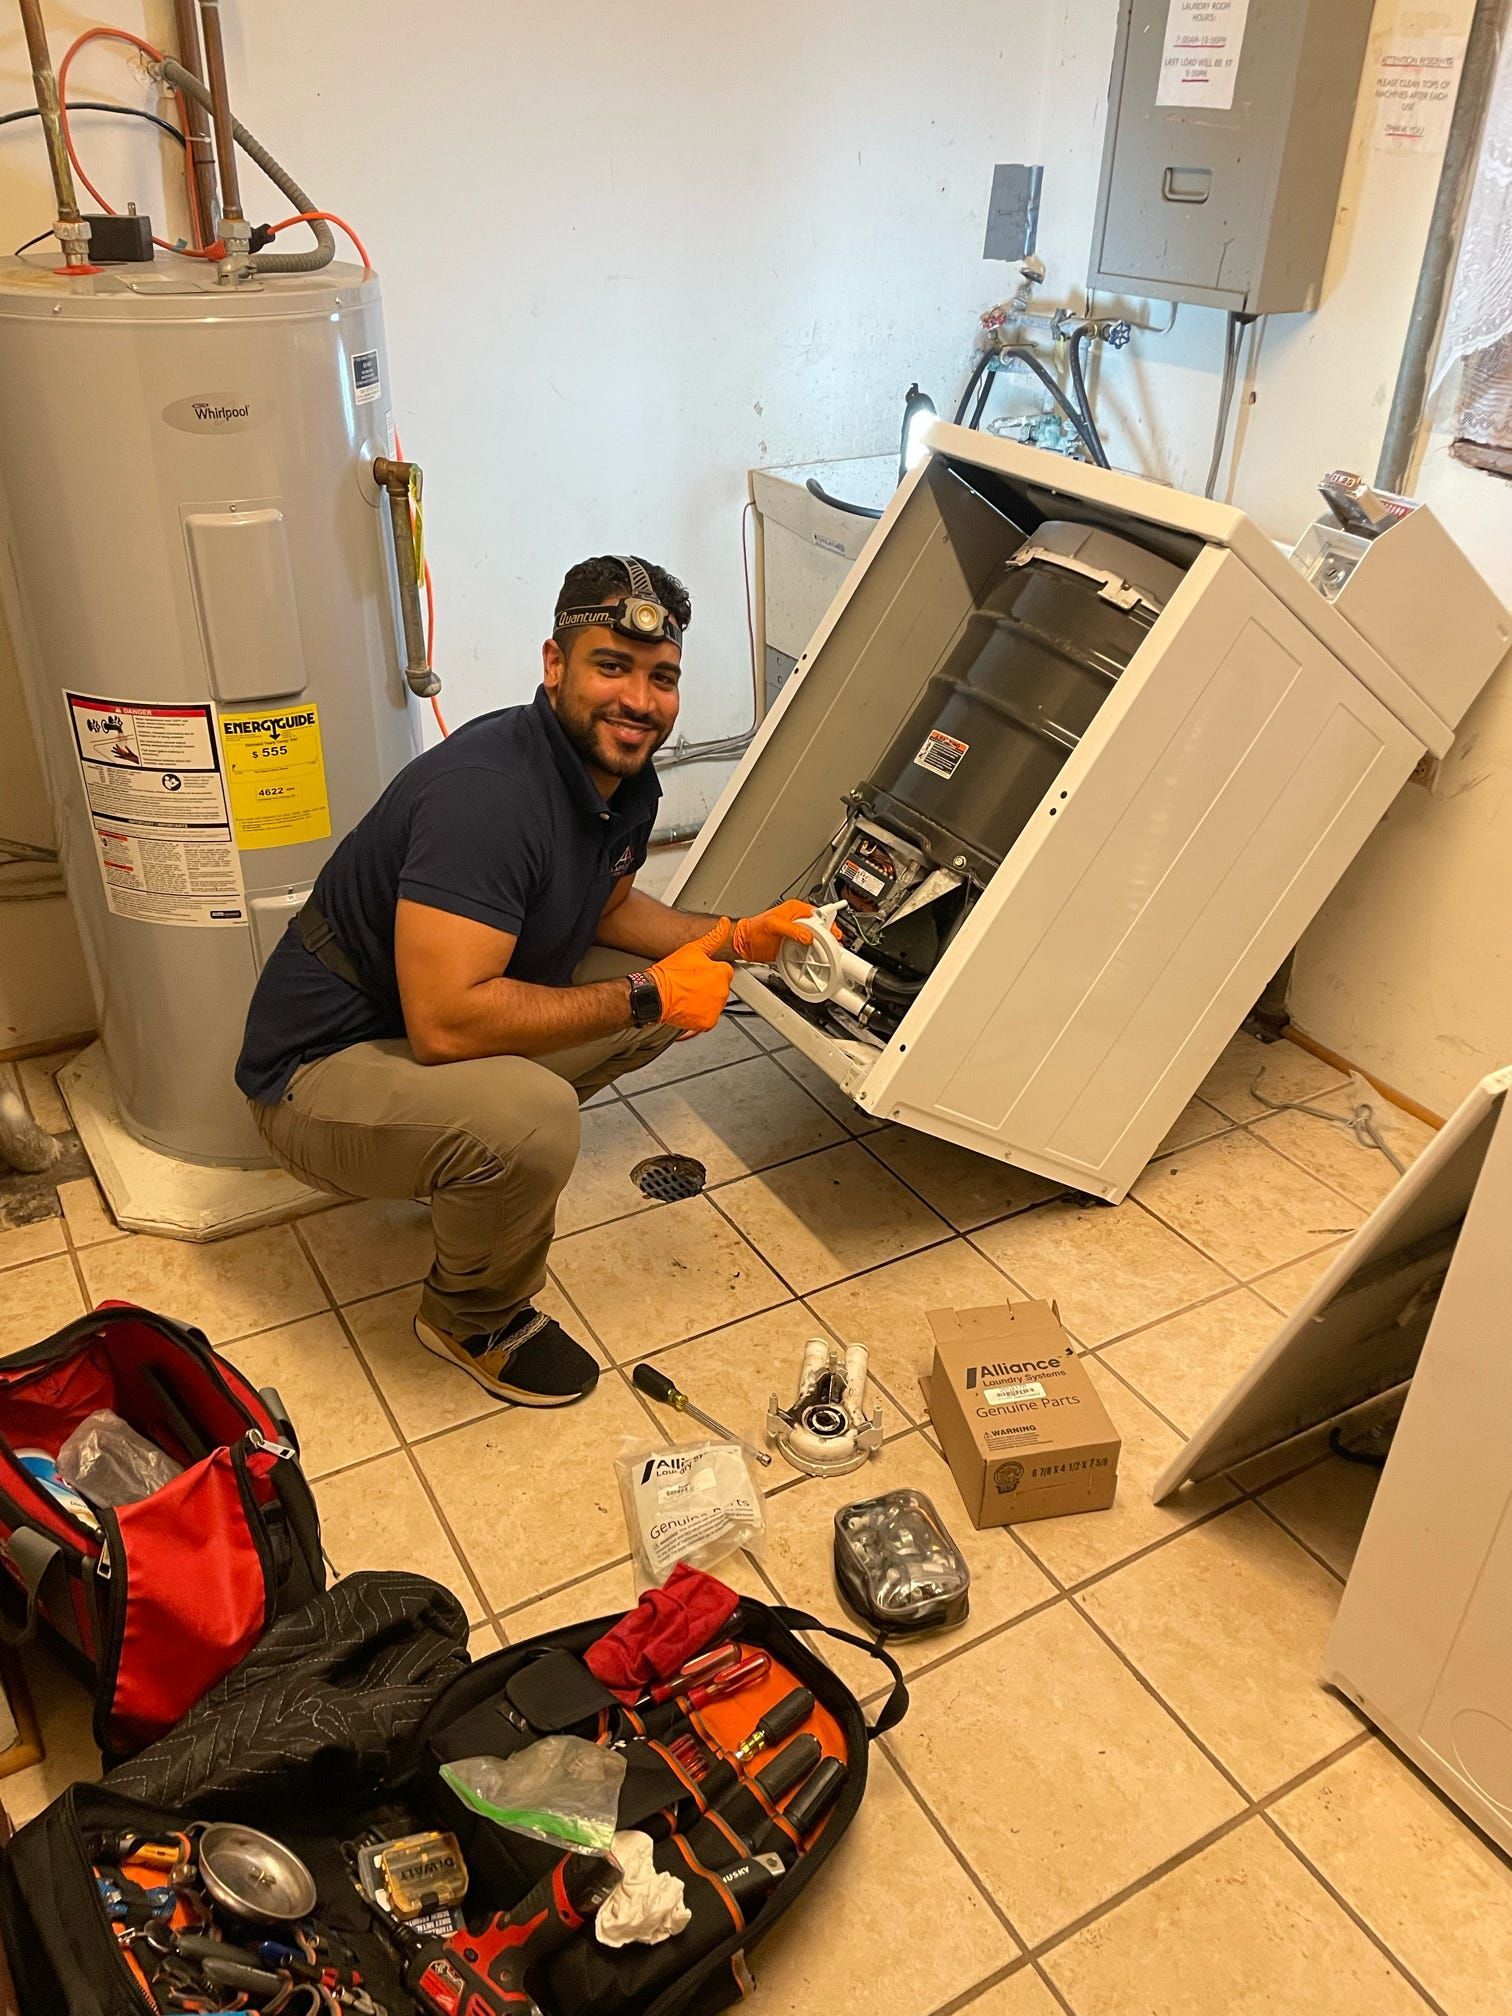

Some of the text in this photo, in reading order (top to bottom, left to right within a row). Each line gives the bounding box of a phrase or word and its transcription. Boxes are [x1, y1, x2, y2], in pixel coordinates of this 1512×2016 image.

[1212, 2, 1231, 10] ROOM
[1164, 58, 1179, 66] LAST
[1181, 58, 1197, 66] LOAD
[1198, 59, 1212, 67] WILL
[195, 404, 248, 421] Whirlpool
[559, 611, 609, 626] Quantum
[123, 708, 152, 716] DANGER
[224, 713, 315, 735] ENERGYGUIDE
[262, 744, 288, 757] 555
[259, 787, 284, 796] 4622
[981, 1359, 1061, 1378] Alliance
[983, 1370, 1066, 1387] Laundry Systems
[976, 1395, 1081, 1418] Genuine Parts
[992, 1425, 1037, 1437] WARNING
